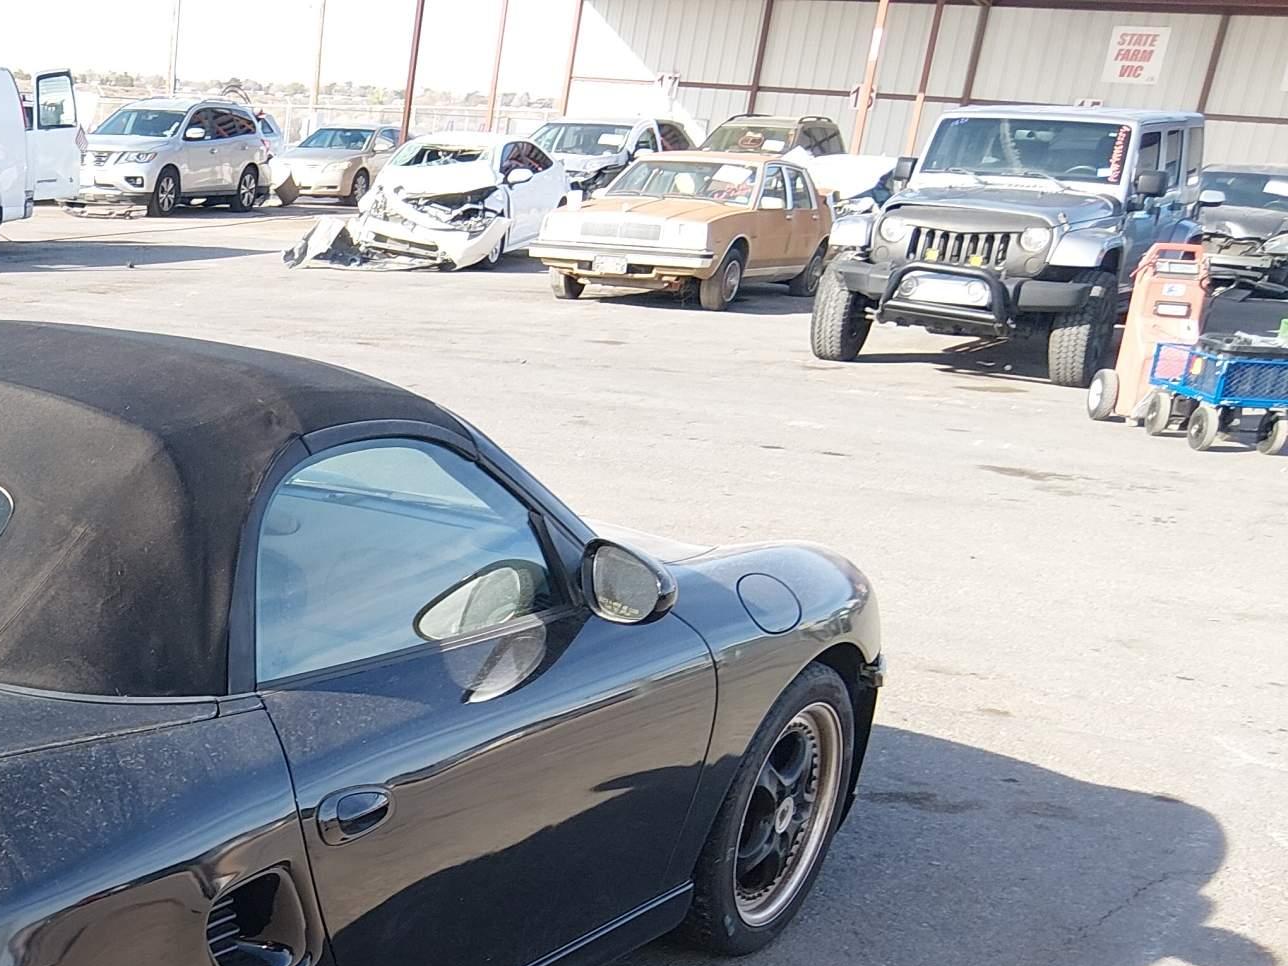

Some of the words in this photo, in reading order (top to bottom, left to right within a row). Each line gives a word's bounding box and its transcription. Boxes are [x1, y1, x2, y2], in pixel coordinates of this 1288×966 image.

[1117, 32, 1160, 47] STATE
[1114, 48, 1154, 63] FARM
[1118, 64, 1144, 78] VIC
